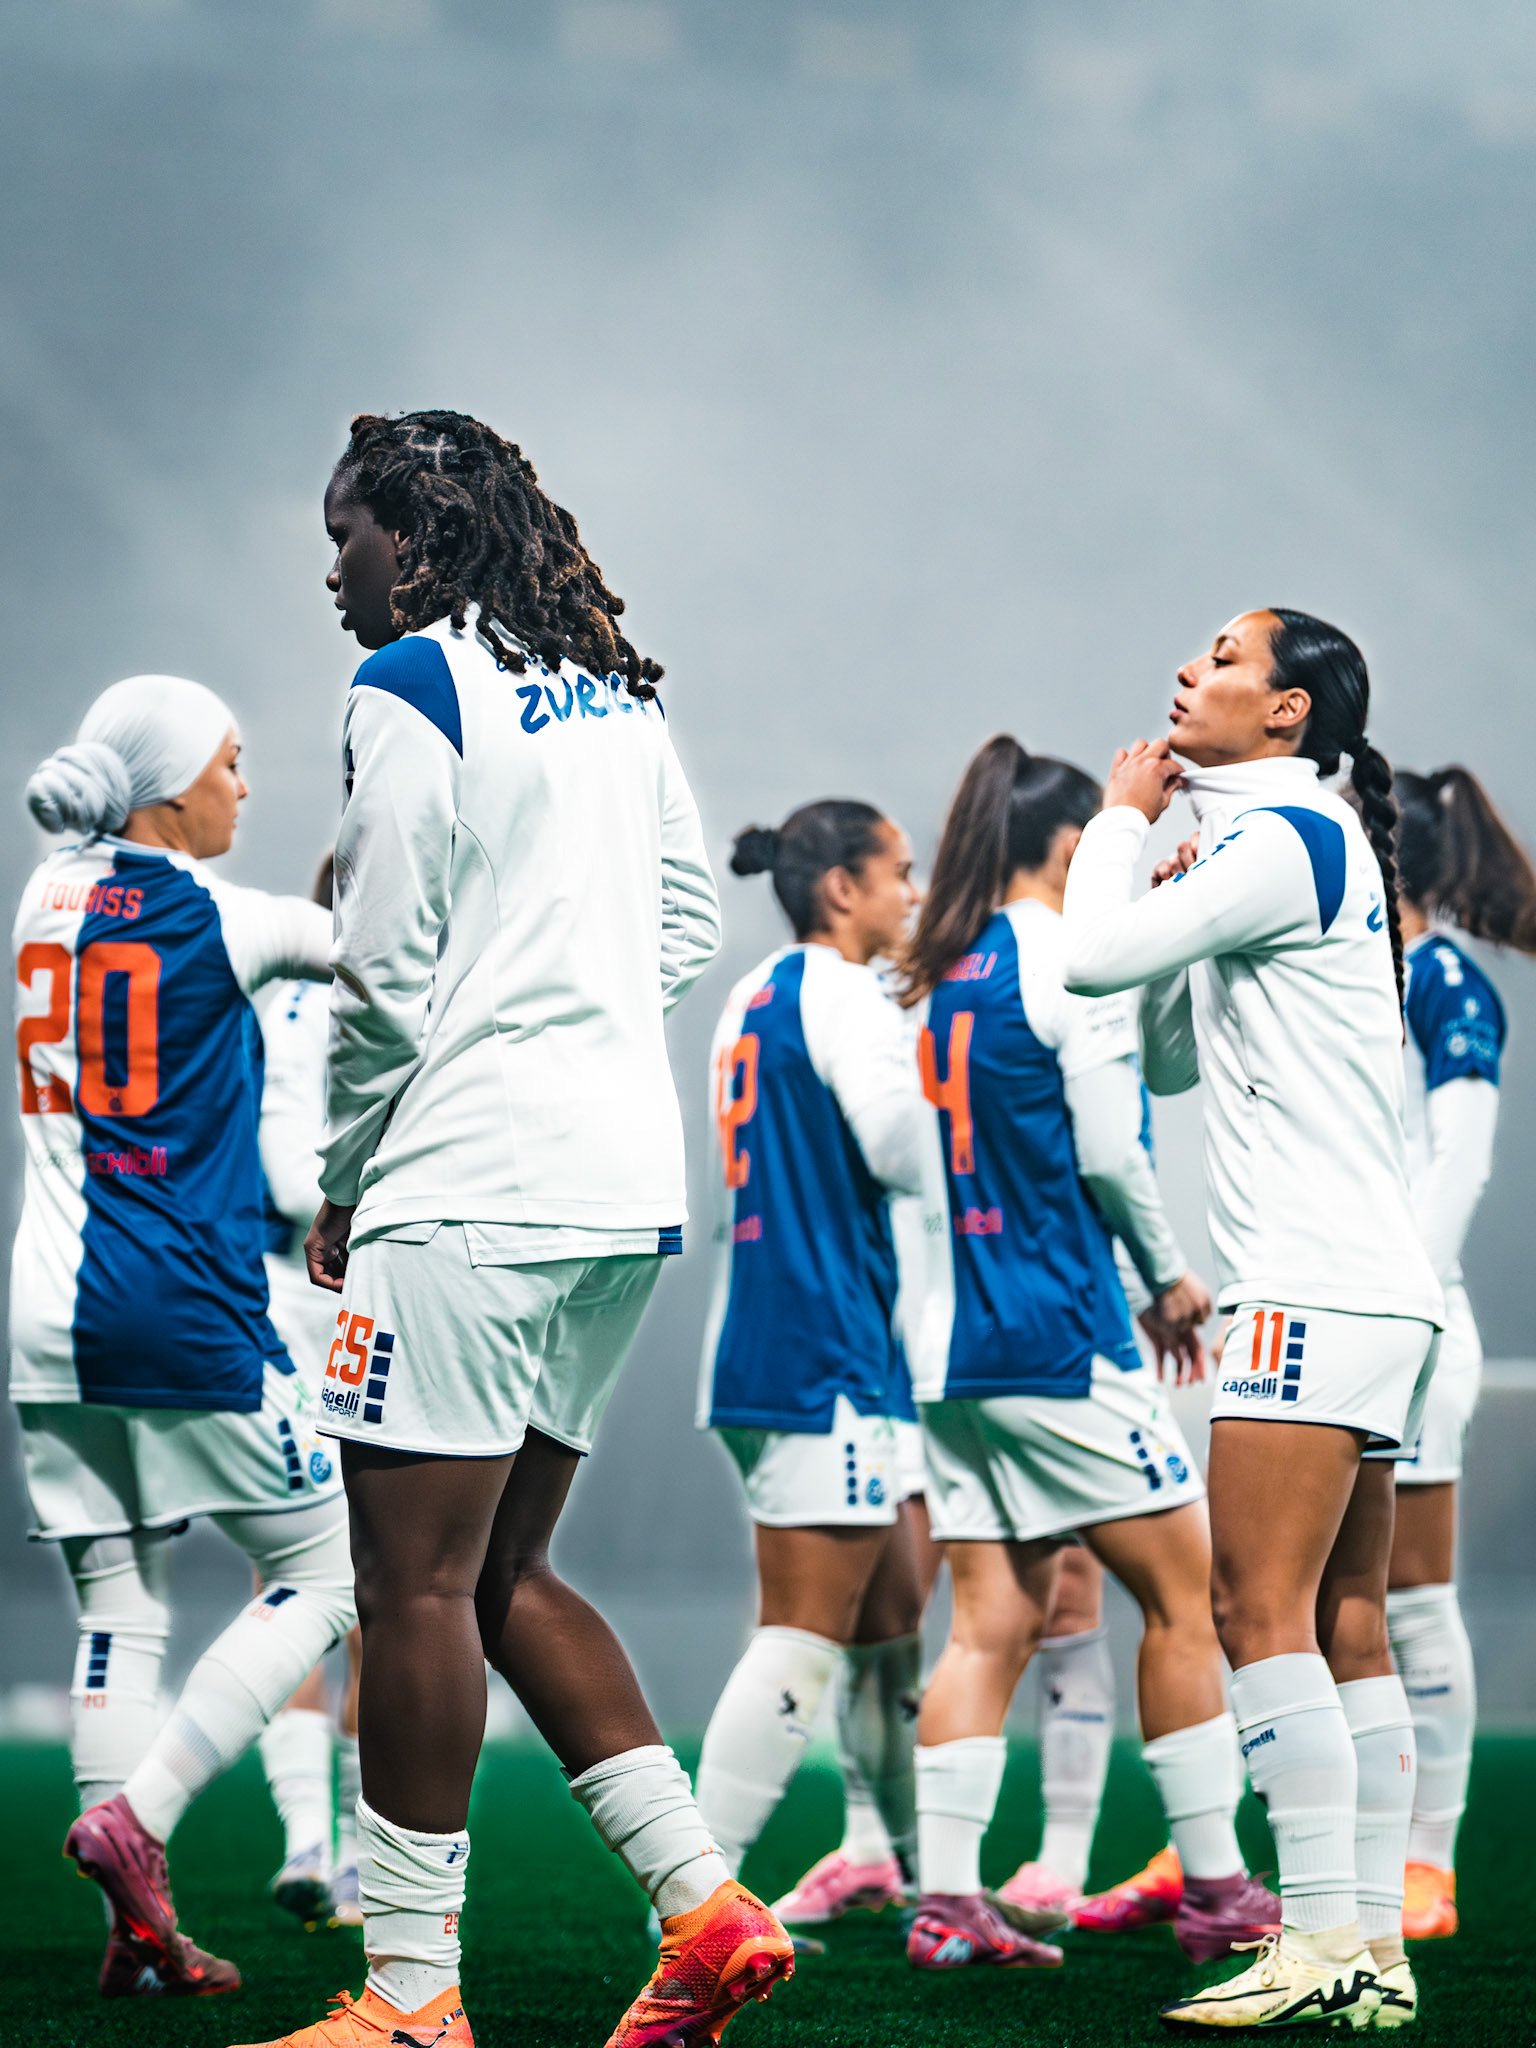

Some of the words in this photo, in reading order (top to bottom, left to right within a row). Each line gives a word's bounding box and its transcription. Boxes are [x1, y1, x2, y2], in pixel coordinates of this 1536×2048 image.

[17, 941, 161, 1117] 20
[916, 1010, 974, 1174] 4
[325, 1309, 374, 1386] 25
[1250, 1310, 1284, 1372] 11
[328, 1404, 357, 1418] SPORT
[1222, 1377, 1277, 1397] capelli
